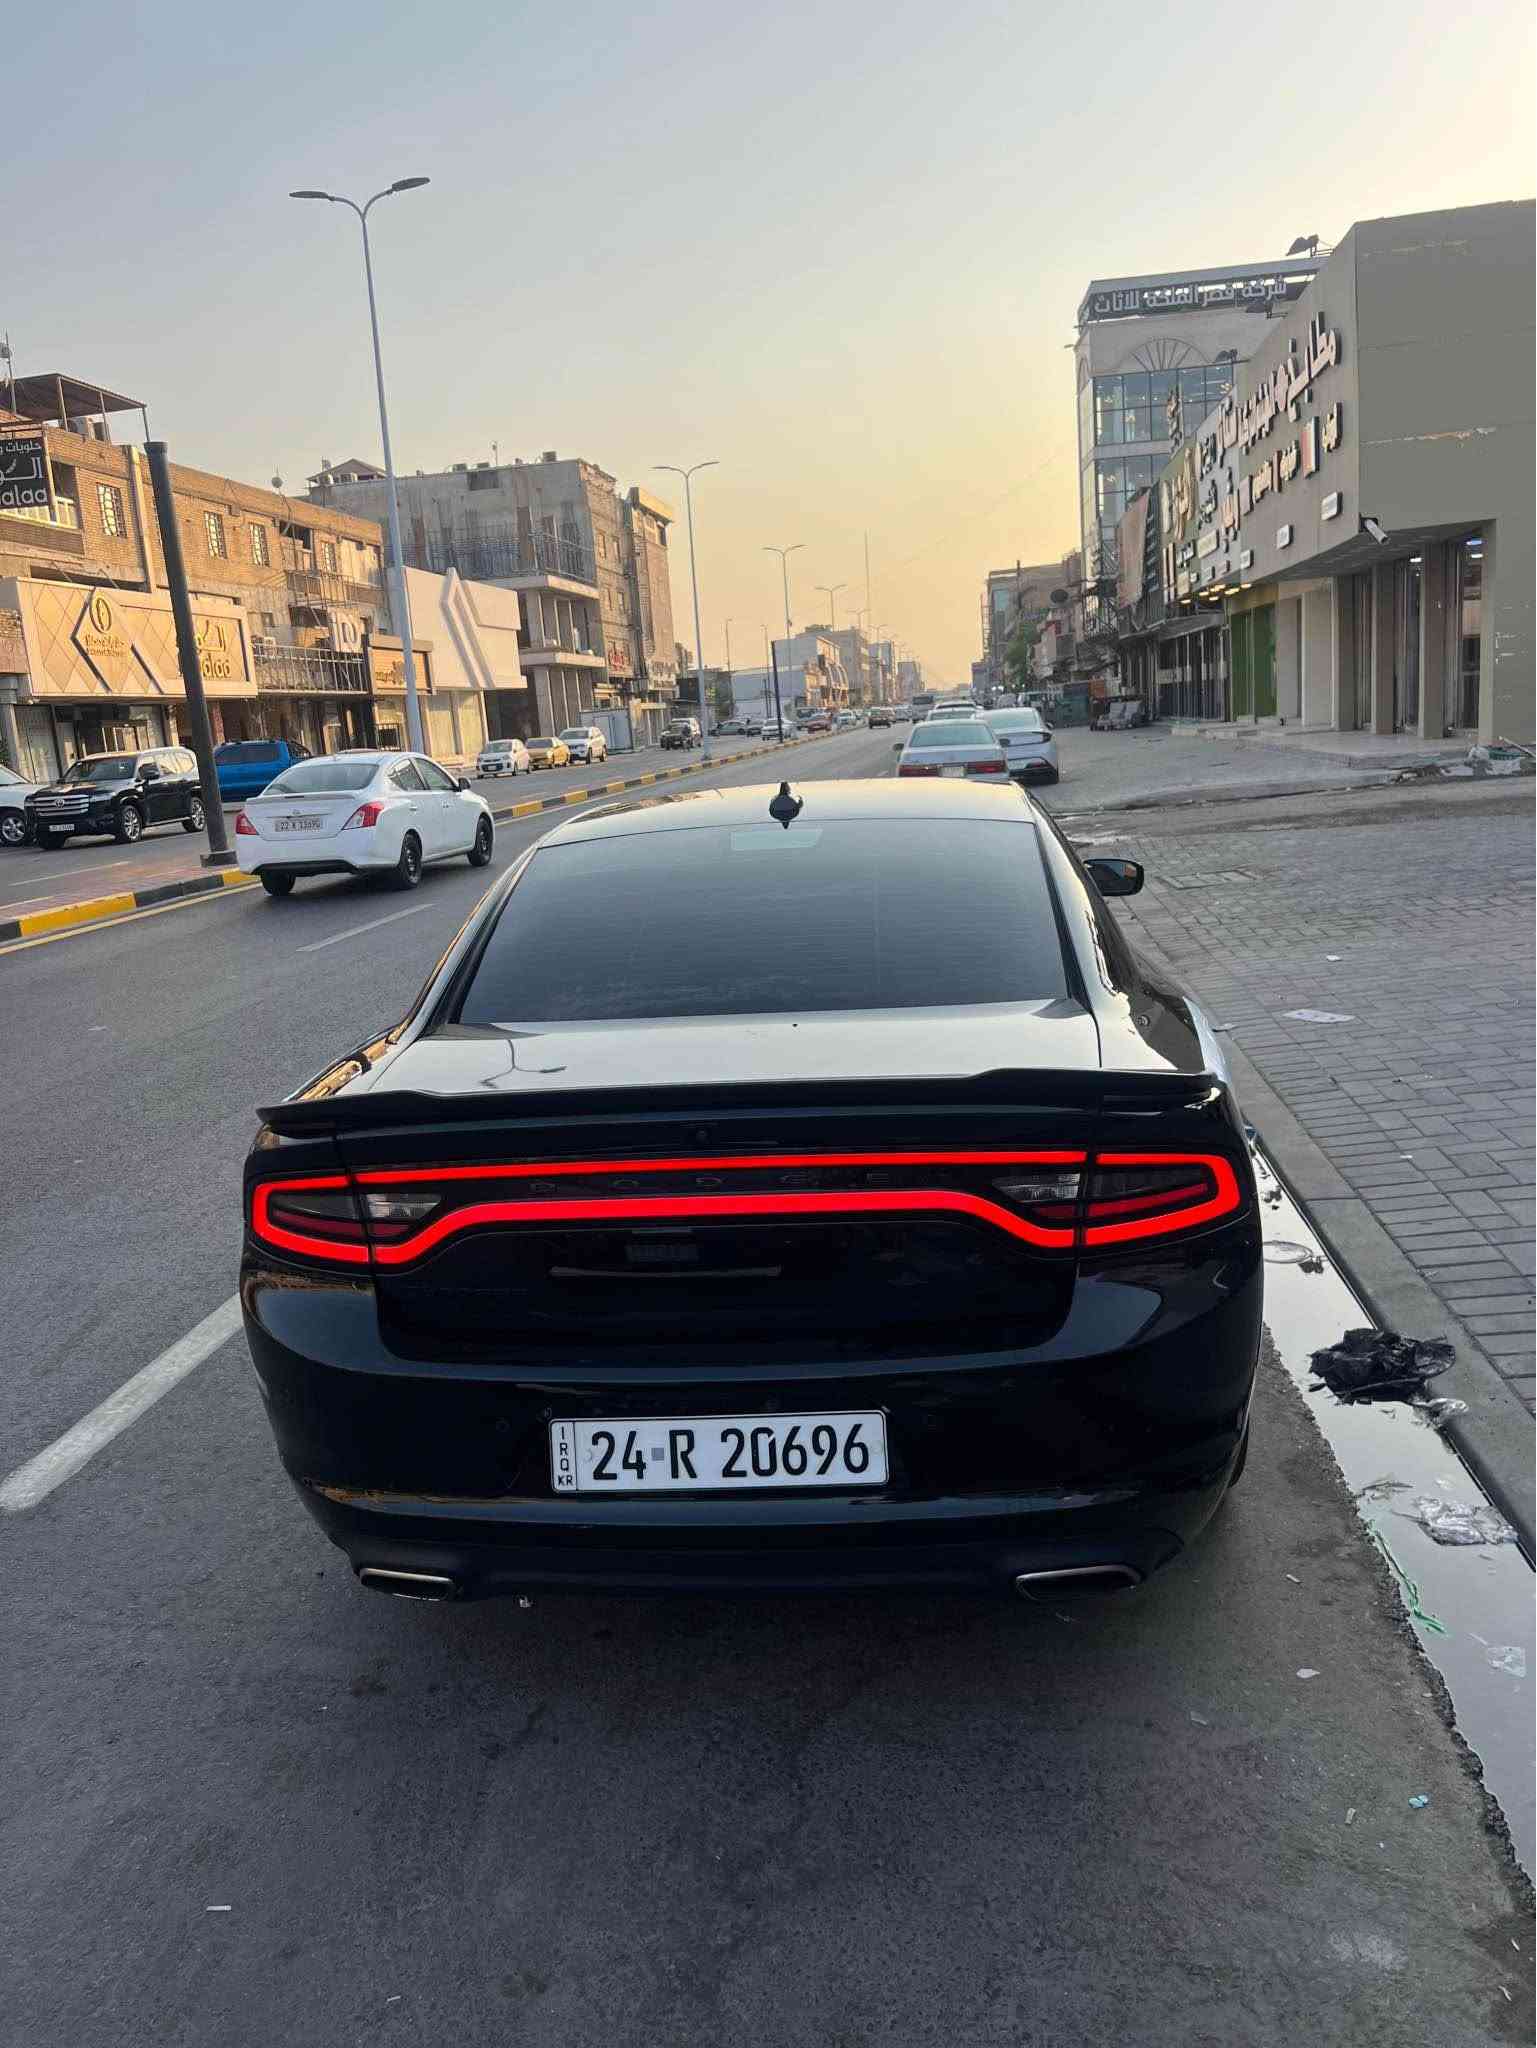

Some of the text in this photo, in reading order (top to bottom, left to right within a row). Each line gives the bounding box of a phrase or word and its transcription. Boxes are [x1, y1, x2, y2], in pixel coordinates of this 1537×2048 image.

[1241, 275, 1287, 300] شركة
[6, 439, 42, 454] حلويات
[0, 484, 48, 506] alaa
[201, 652, 232, 679] alaa
[591, 1423, 870, 1481] 24 R 20696
[557, 1475, 573, 1487] KR
